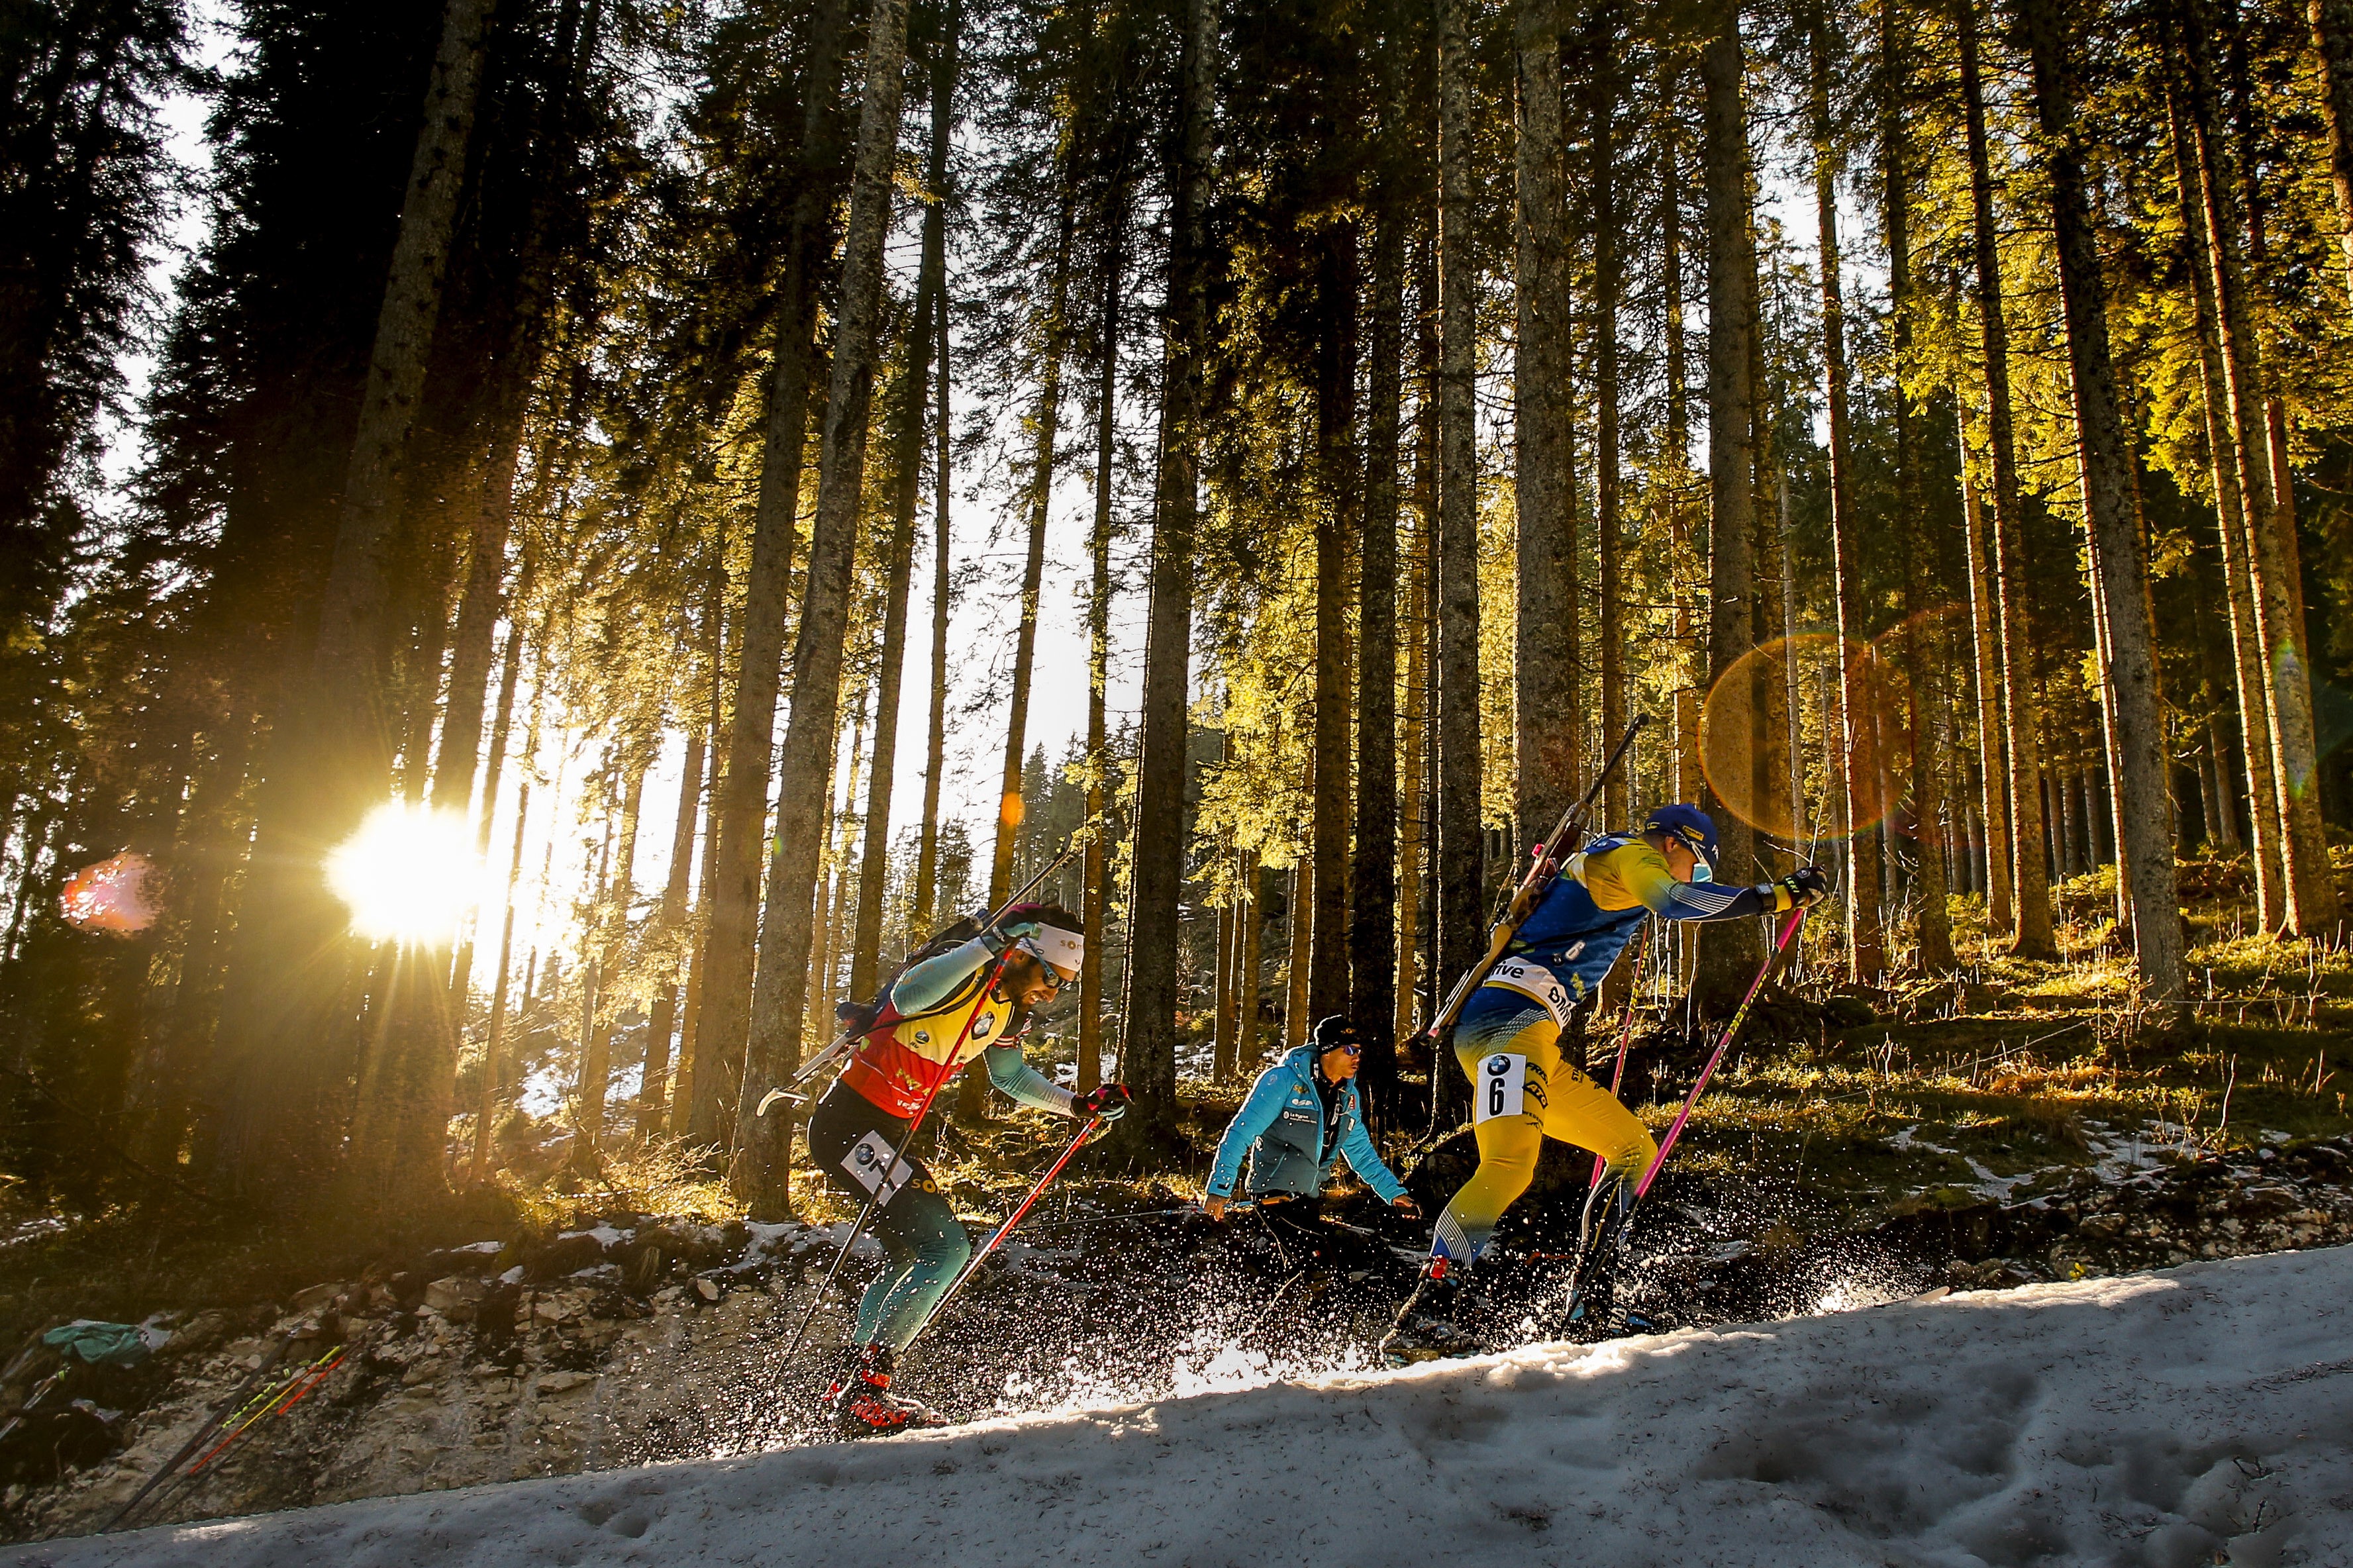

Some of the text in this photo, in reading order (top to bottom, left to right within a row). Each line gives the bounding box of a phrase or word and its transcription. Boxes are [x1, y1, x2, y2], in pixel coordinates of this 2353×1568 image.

[1785, 877, 1800, 893] LEKI
[1565, 940, 1586, 961] 6
[1489, 1077, 1505, 1116] 6
